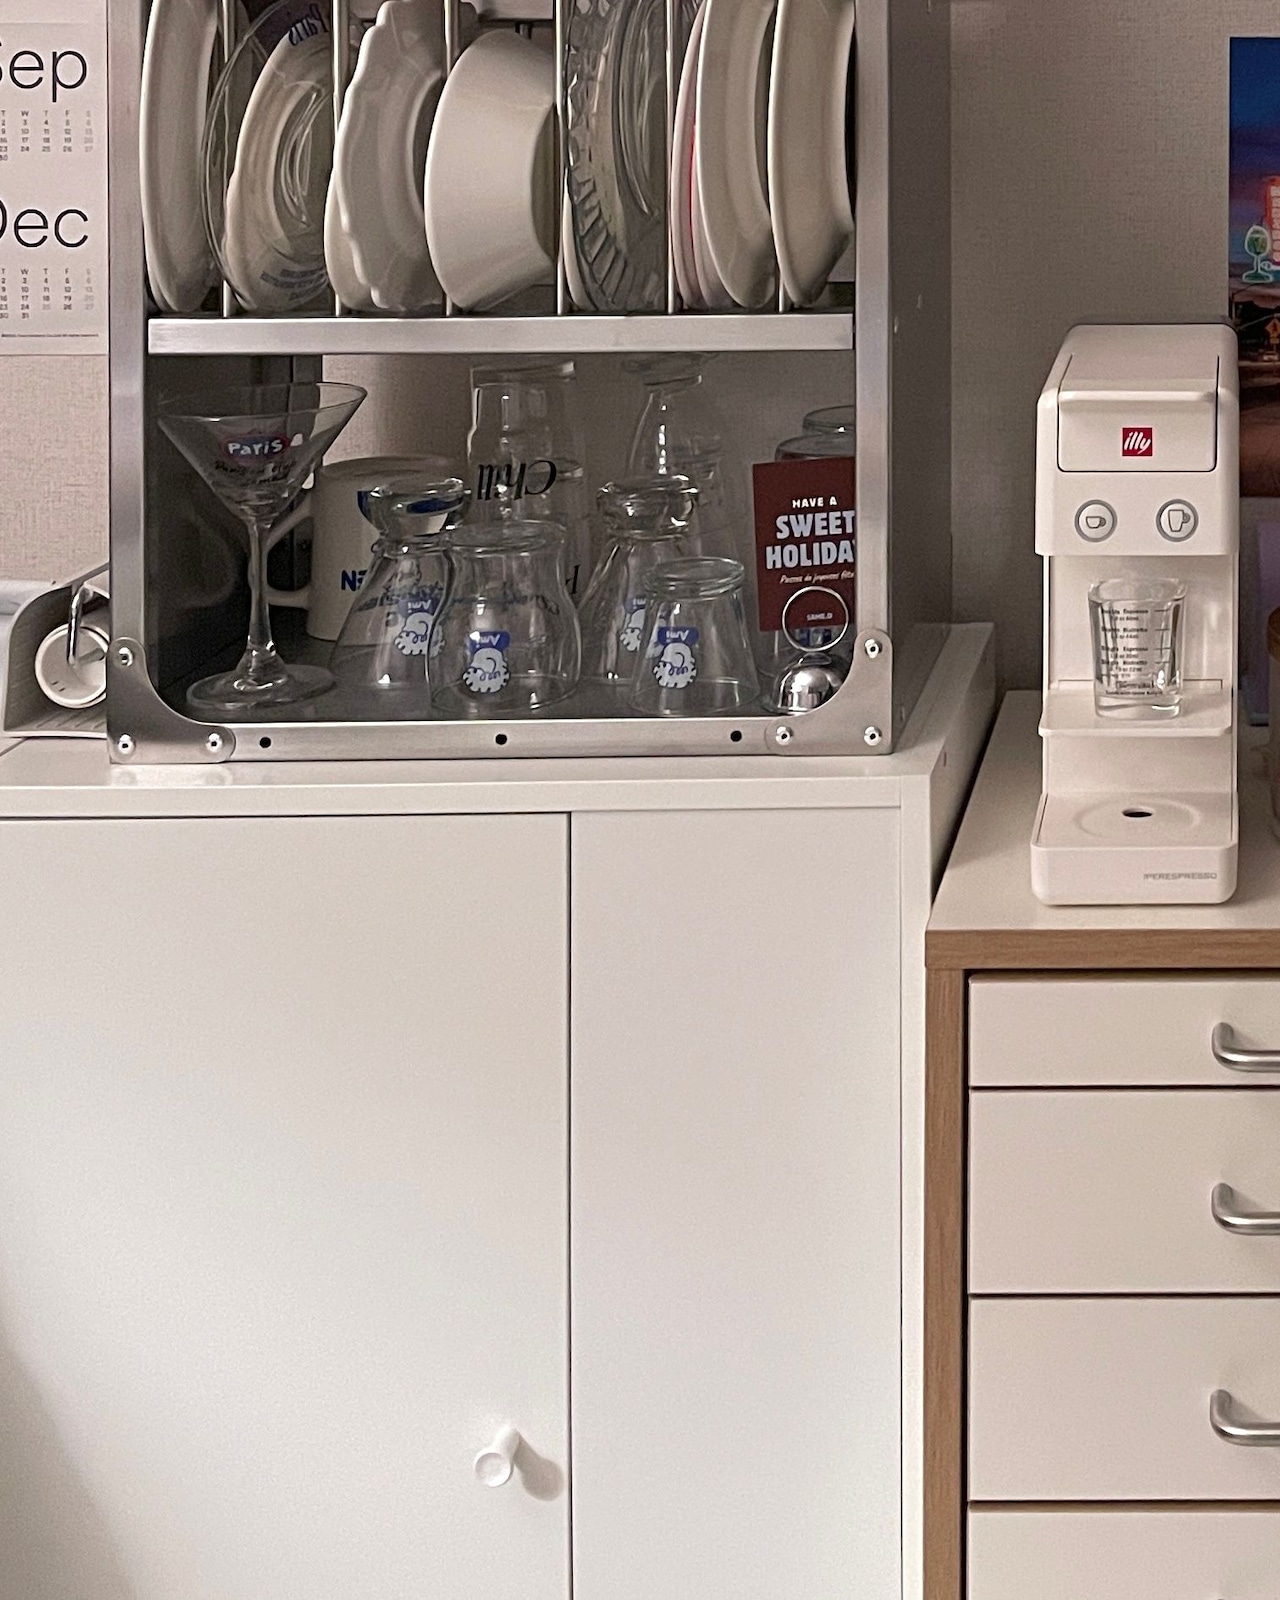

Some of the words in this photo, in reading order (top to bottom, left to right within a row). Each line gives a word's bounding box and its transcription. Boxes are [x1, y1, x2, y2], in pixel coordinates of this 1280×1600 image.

[1123, 431, 1151, 455] illy
[477, 460, 557, 501] Chill
[792, 497, 824, 509] HAVE
[829, 496, 838, 506] A
[776, 509, 856, 540] SWEET
[765, 539, 856, 570] HOLIDA
[408, 600, 431, 613] Ami
[666, 629, 690, 642] Ami
